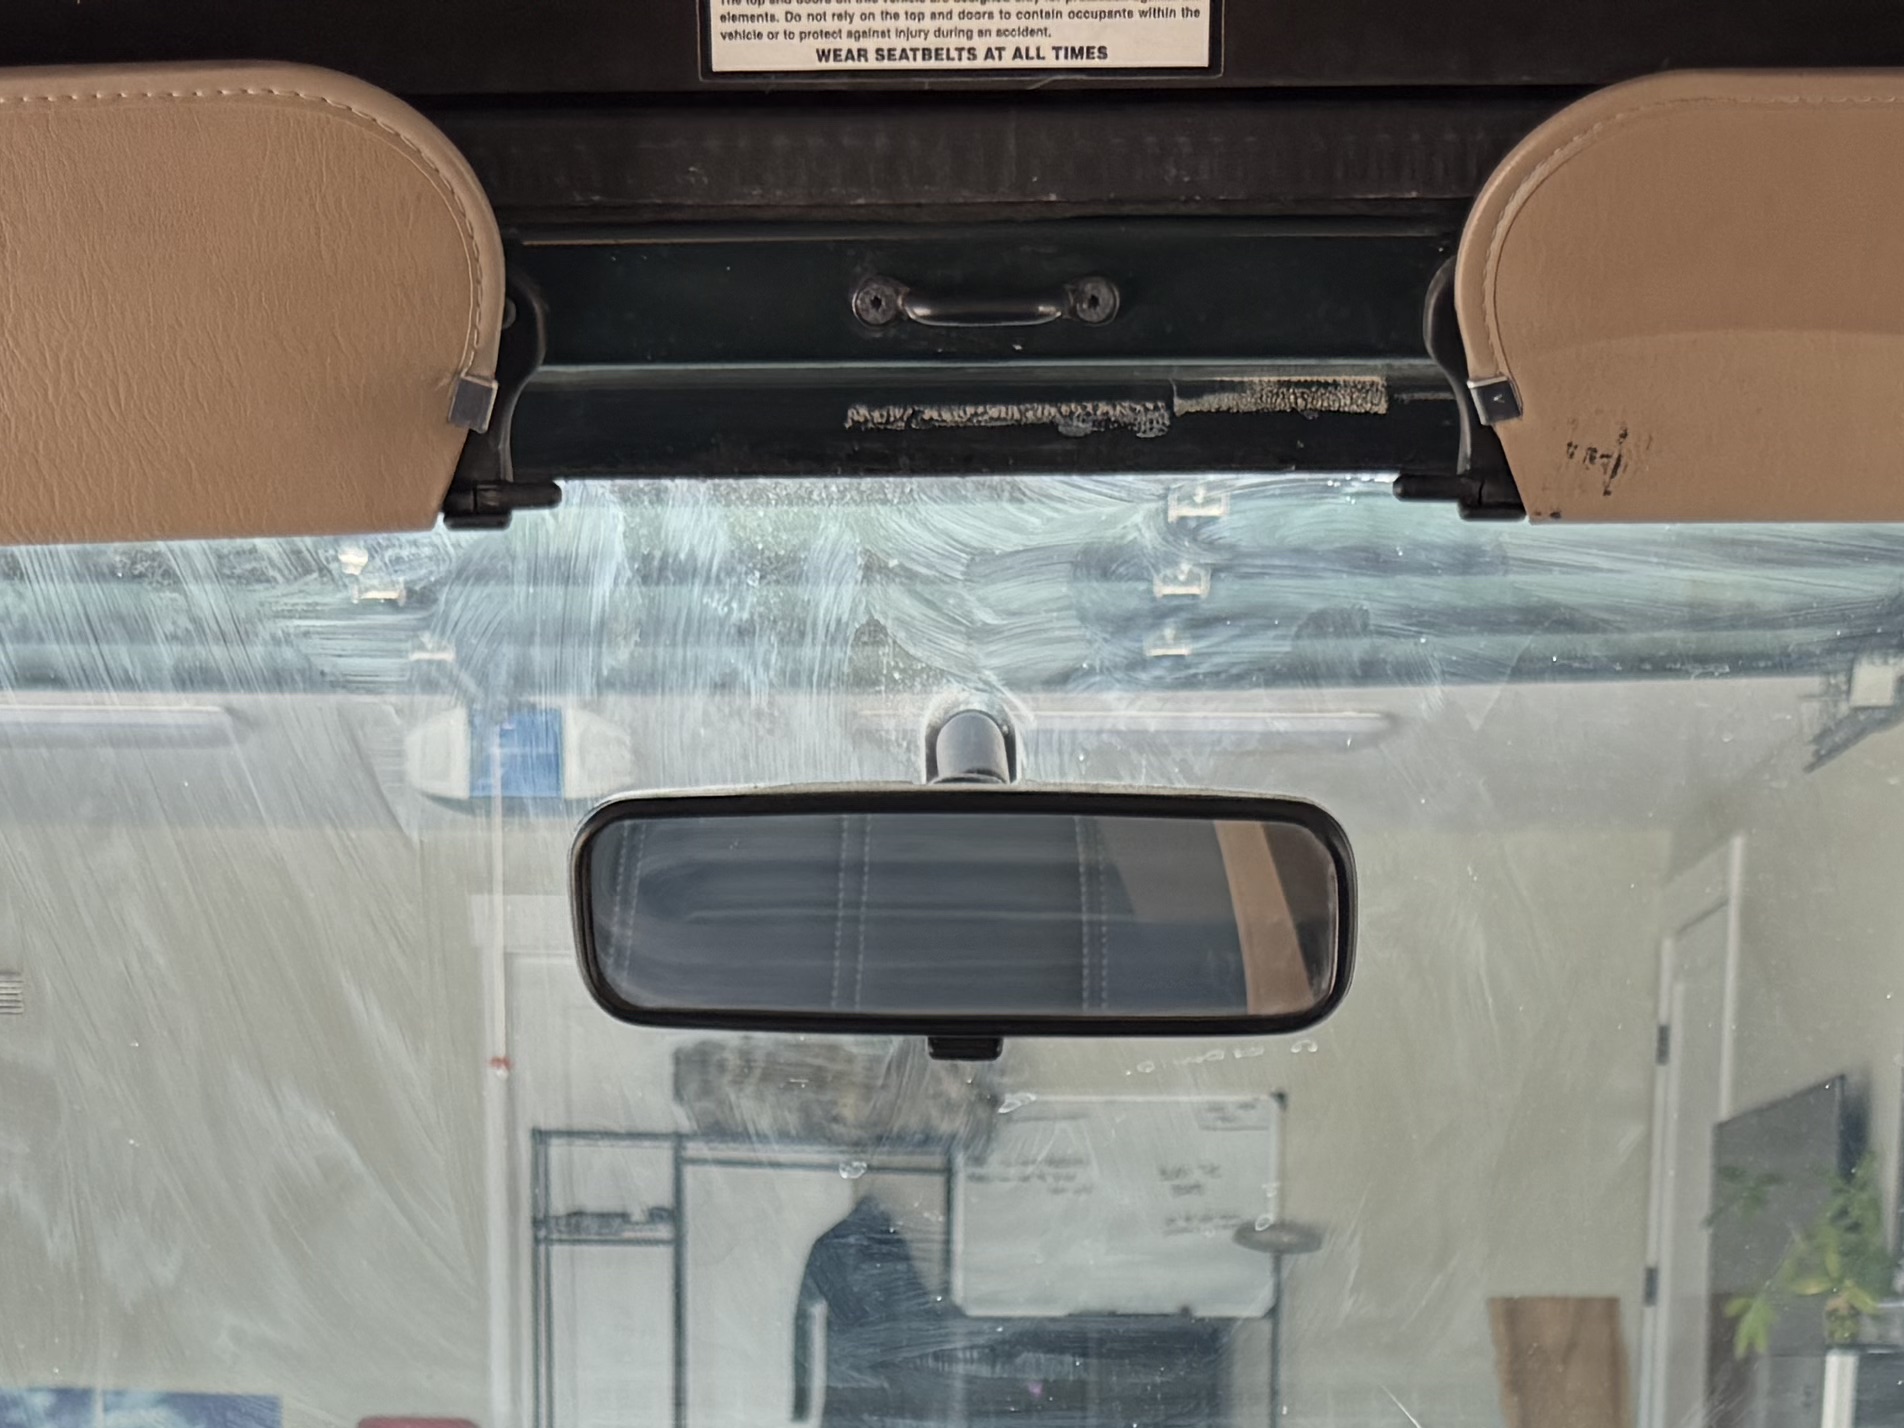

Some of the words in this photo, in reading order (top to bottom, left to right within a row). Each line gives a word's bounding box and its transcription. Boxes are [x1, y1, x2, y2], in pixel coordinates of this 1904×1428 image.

[720, 12, 779, 23] elements.
[785, 11, 801, 22] Do
[807, 11, 826, 22] not
[832, 11, 854, 24] rely
[860, 13, 875, 21] on
[881, 10, 899, 21] the
[905, 11, 924, 23] top
[930, 10, 952, 21] and
[958, 9, 994, 20] doors
[999, 10, 1011, 20] to
[1016, 9, 1062, 19] contain
[1068, 9, 1133, 21] occupants
[1138, 8, 1176, 18] within
[1181, 8, 1200, 18] the
[720, 29, 762, 41] vehicle
[767, 30, 779, 40] or
[784, 29, 795, 40] to
[799, 29, 842, 42] protect
[847, 28, 890, 42] against
[895, 27, 929, 41] injury
[934, 26, 973, 40] during
[978, 28, 991, 38] an
[996, 26, 1051, 38] accident.
[816, 48, 869, 62] WEAR
[875, 46, 977, 62] SEATBELTS
[983, 47, 1006, 61] AT
[1012, 46, 1045, 61] ALL
[1052, 46, 1108, 60] TIMES
